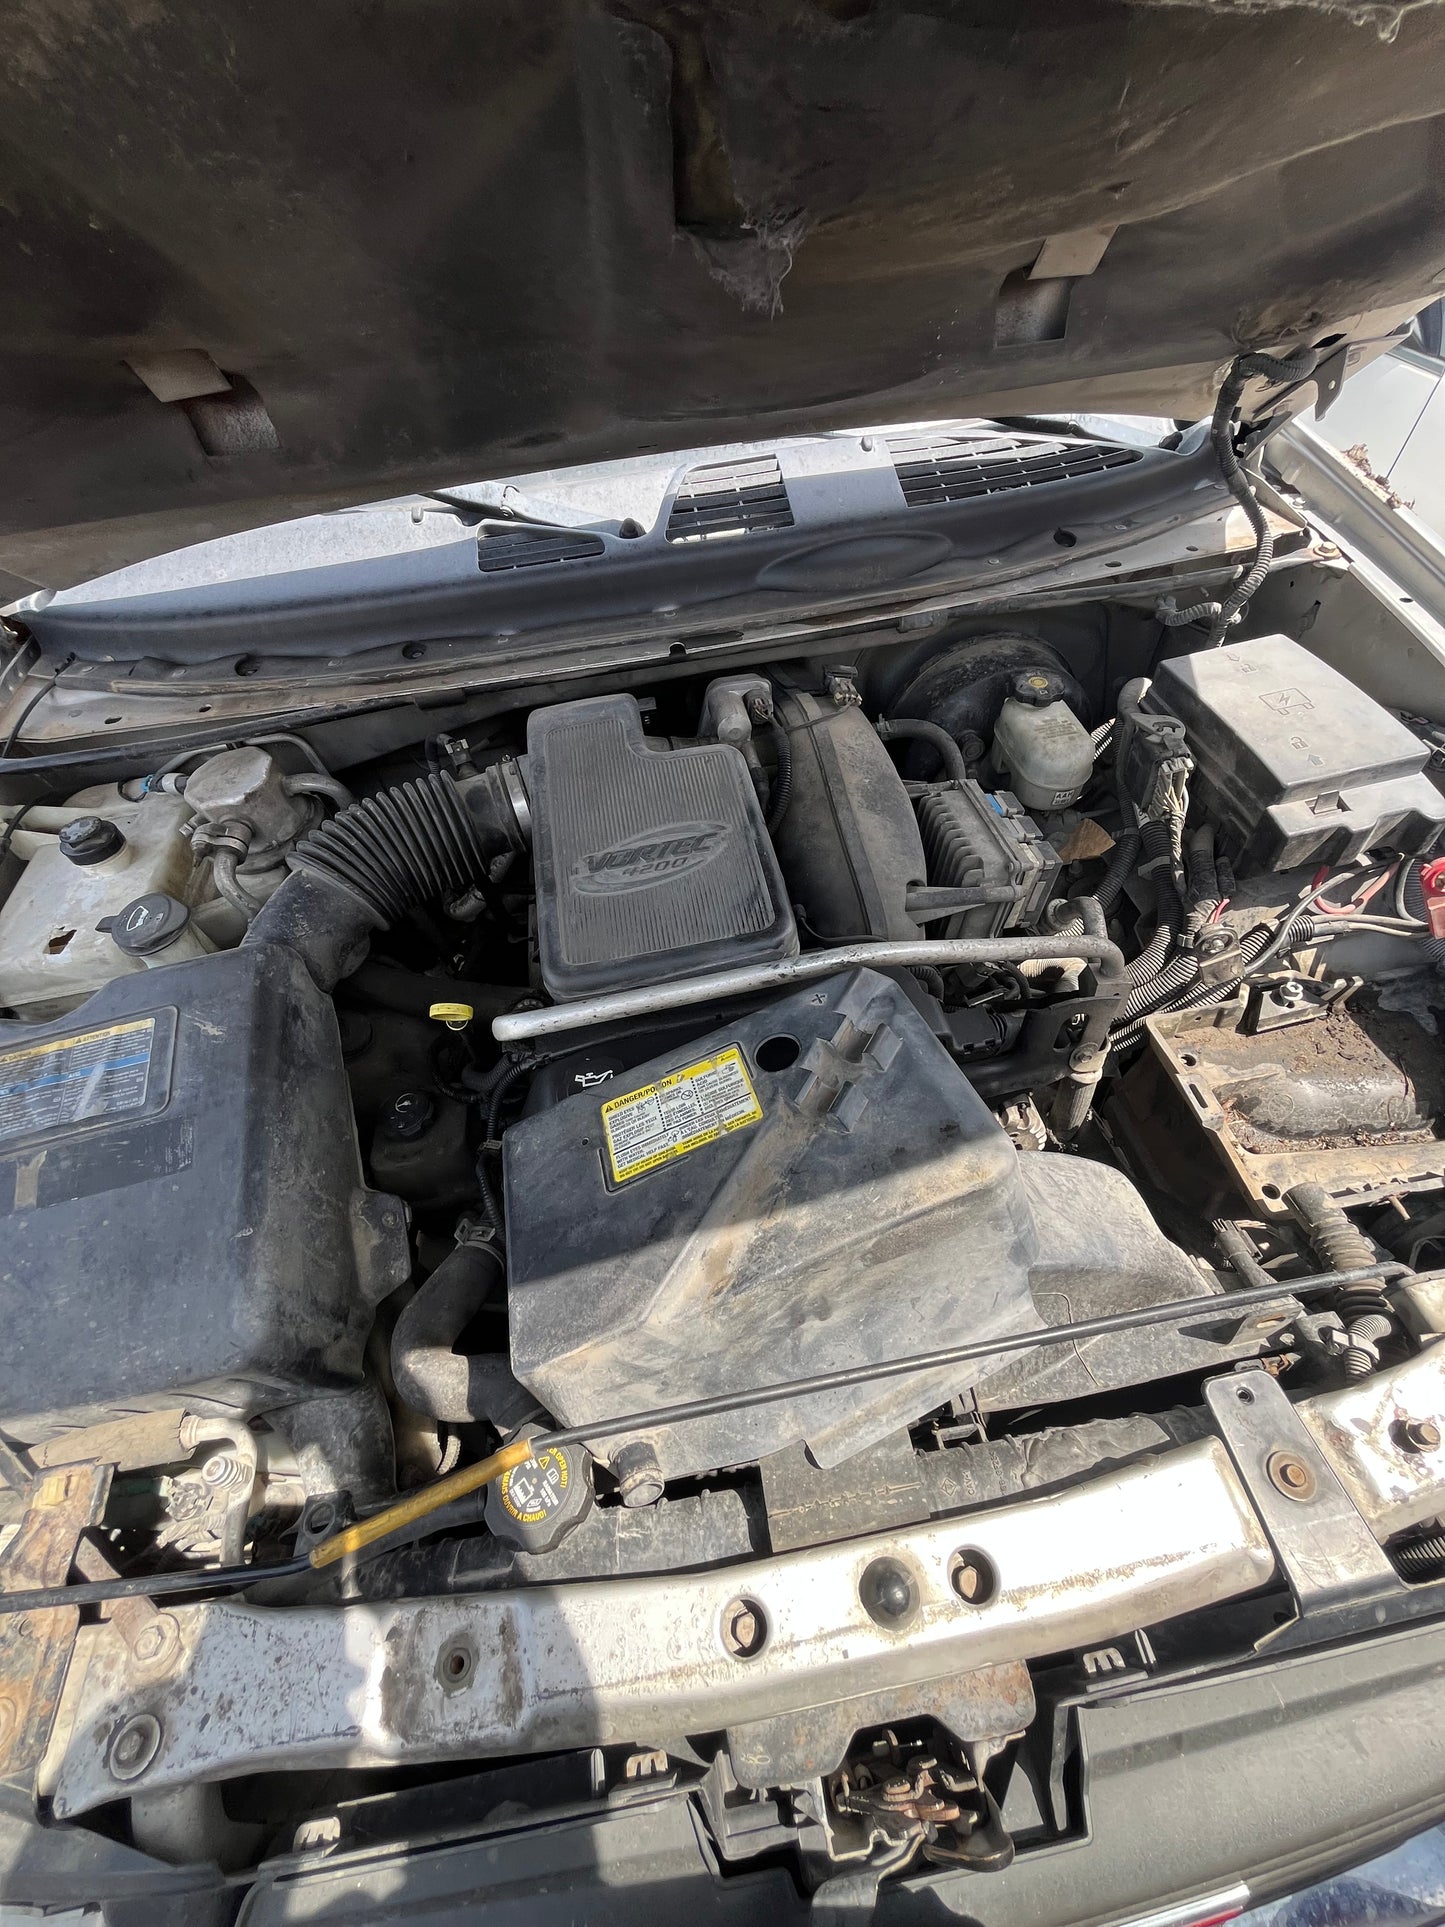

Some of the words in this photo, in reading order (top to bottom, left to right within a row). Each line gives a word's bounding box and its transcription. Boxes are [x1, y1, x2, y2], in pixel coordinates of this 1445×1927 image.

[586, 833, 718, 873] VORTEC
[622, 857, 689, 876] 4200
[613, 1078, 672, 1108] DANGER/POON
